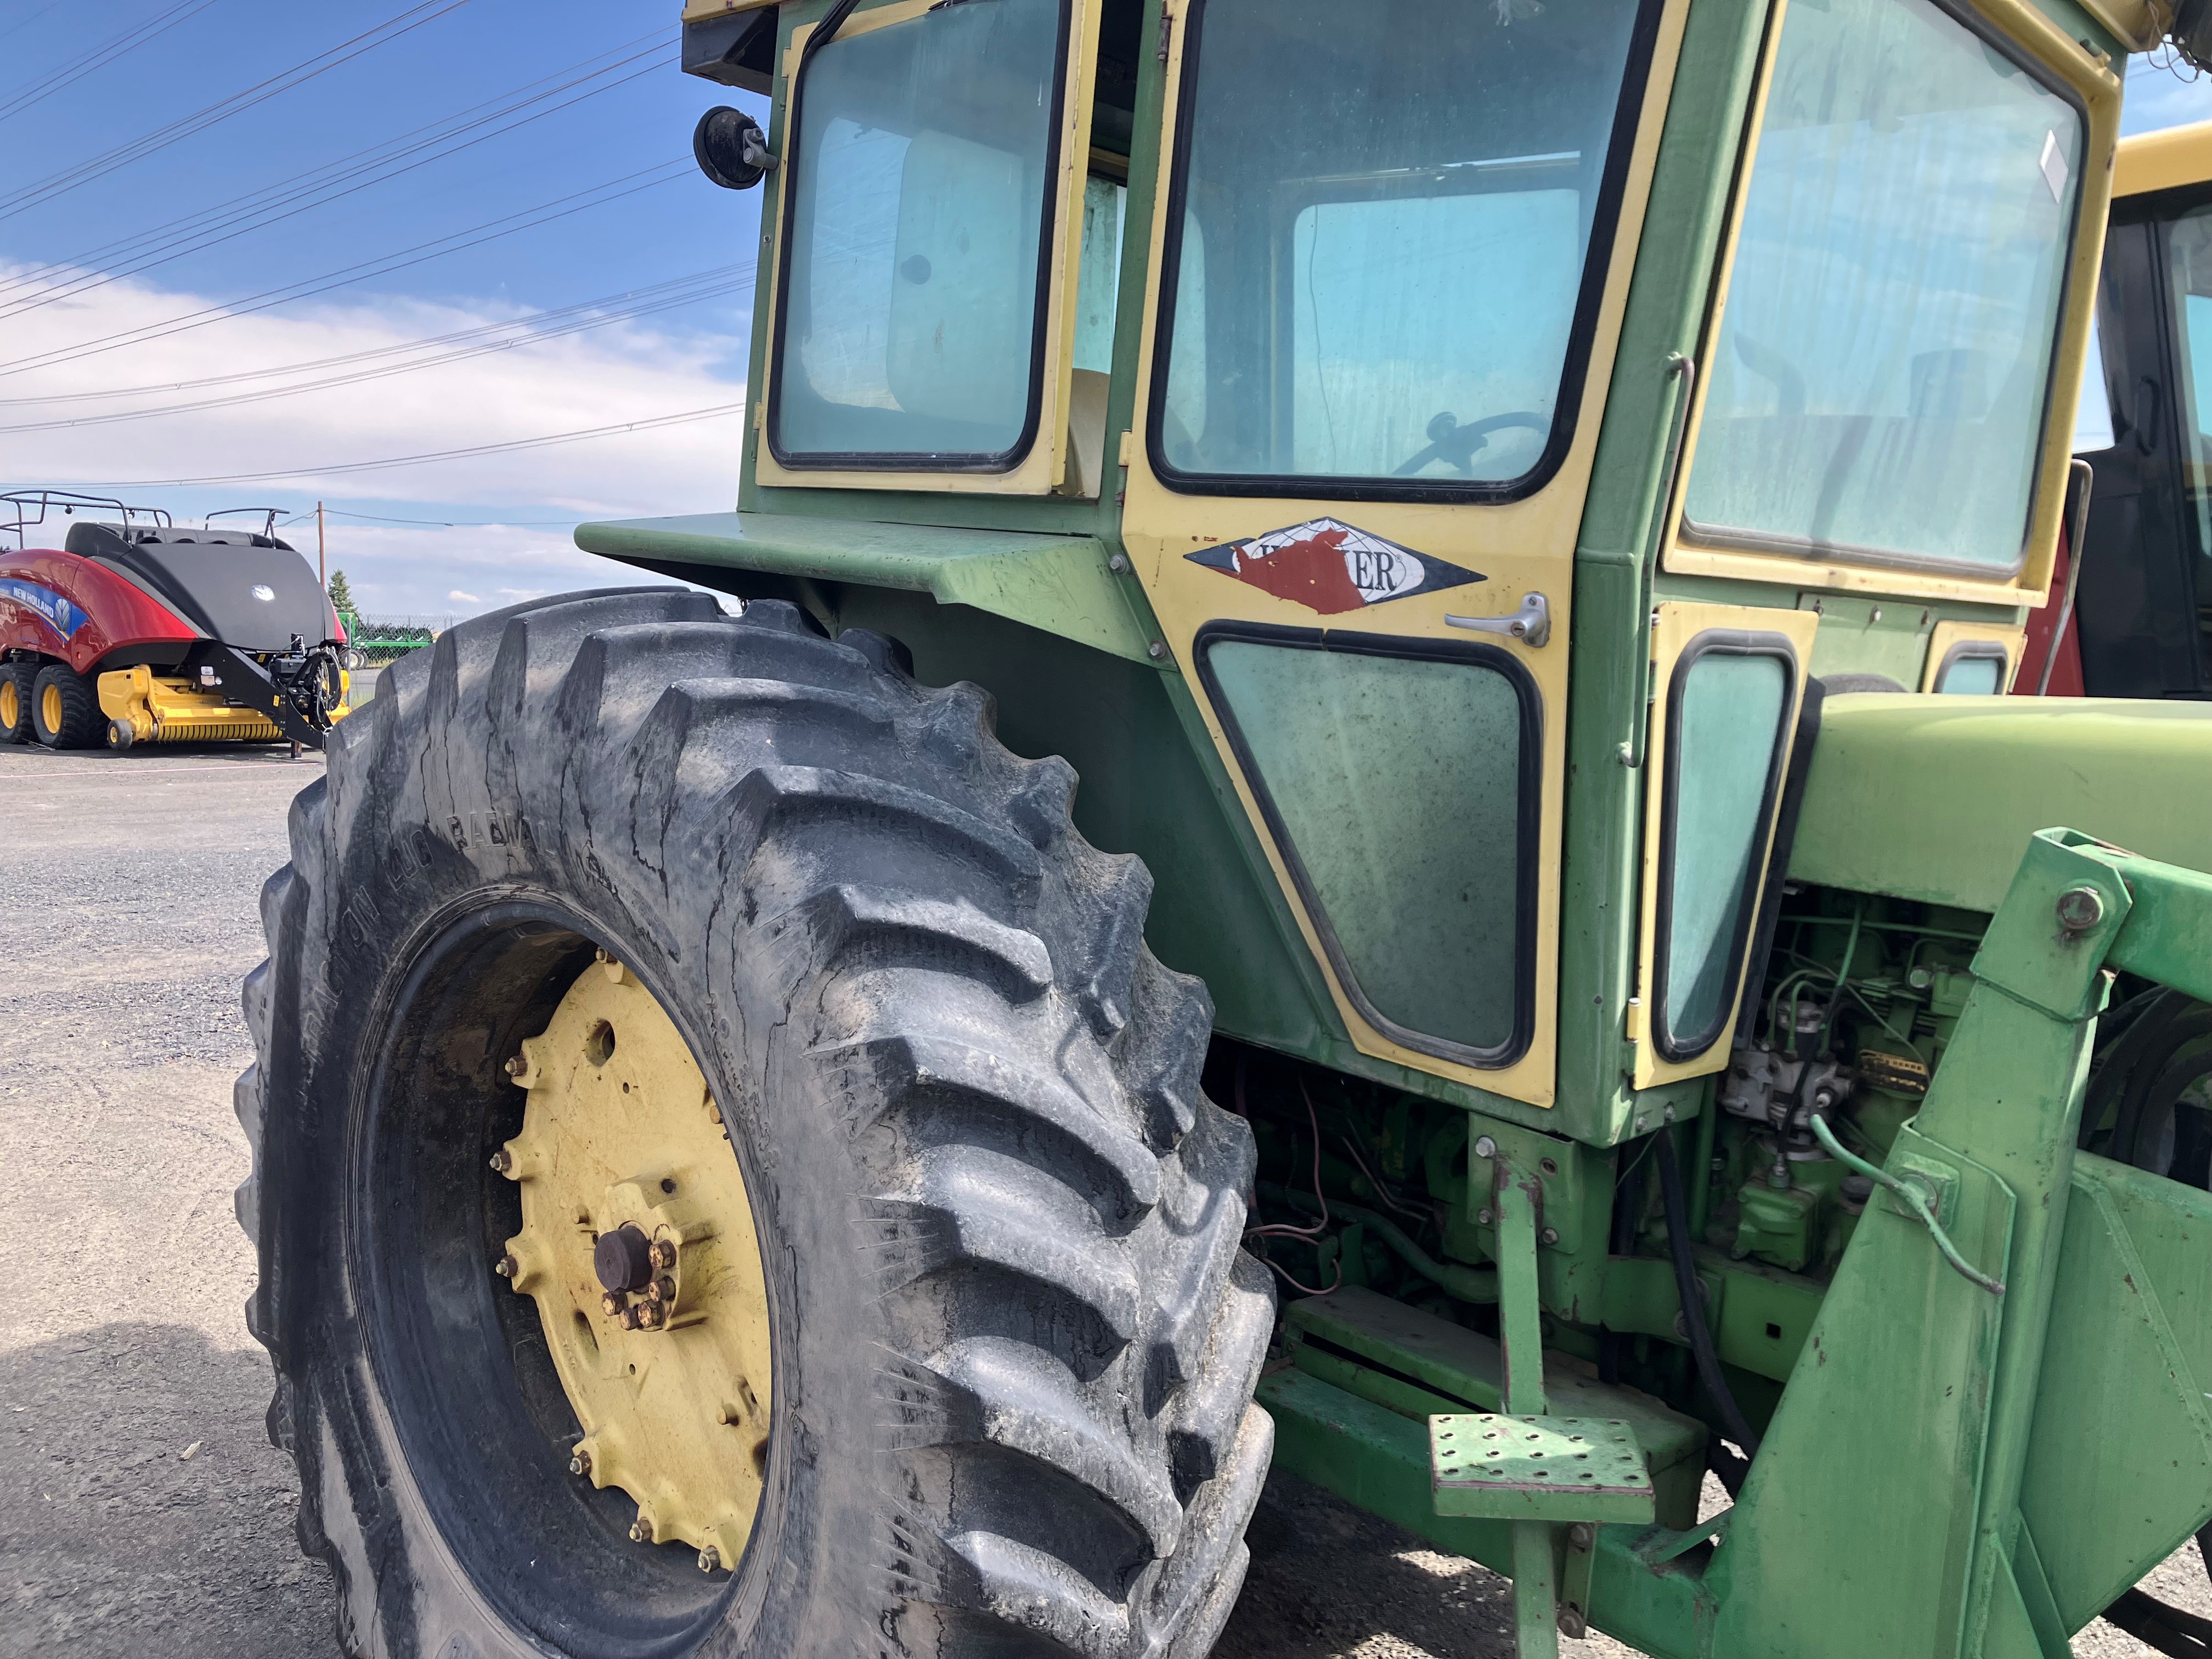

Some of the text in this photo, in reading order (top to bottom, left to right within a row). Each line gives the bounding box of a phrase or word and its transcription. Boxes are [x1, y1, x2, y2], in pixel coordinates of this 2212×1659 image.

[13, 586, 54, 618] NEW HOLLAND
[382, 830, 433, 893] LUG
